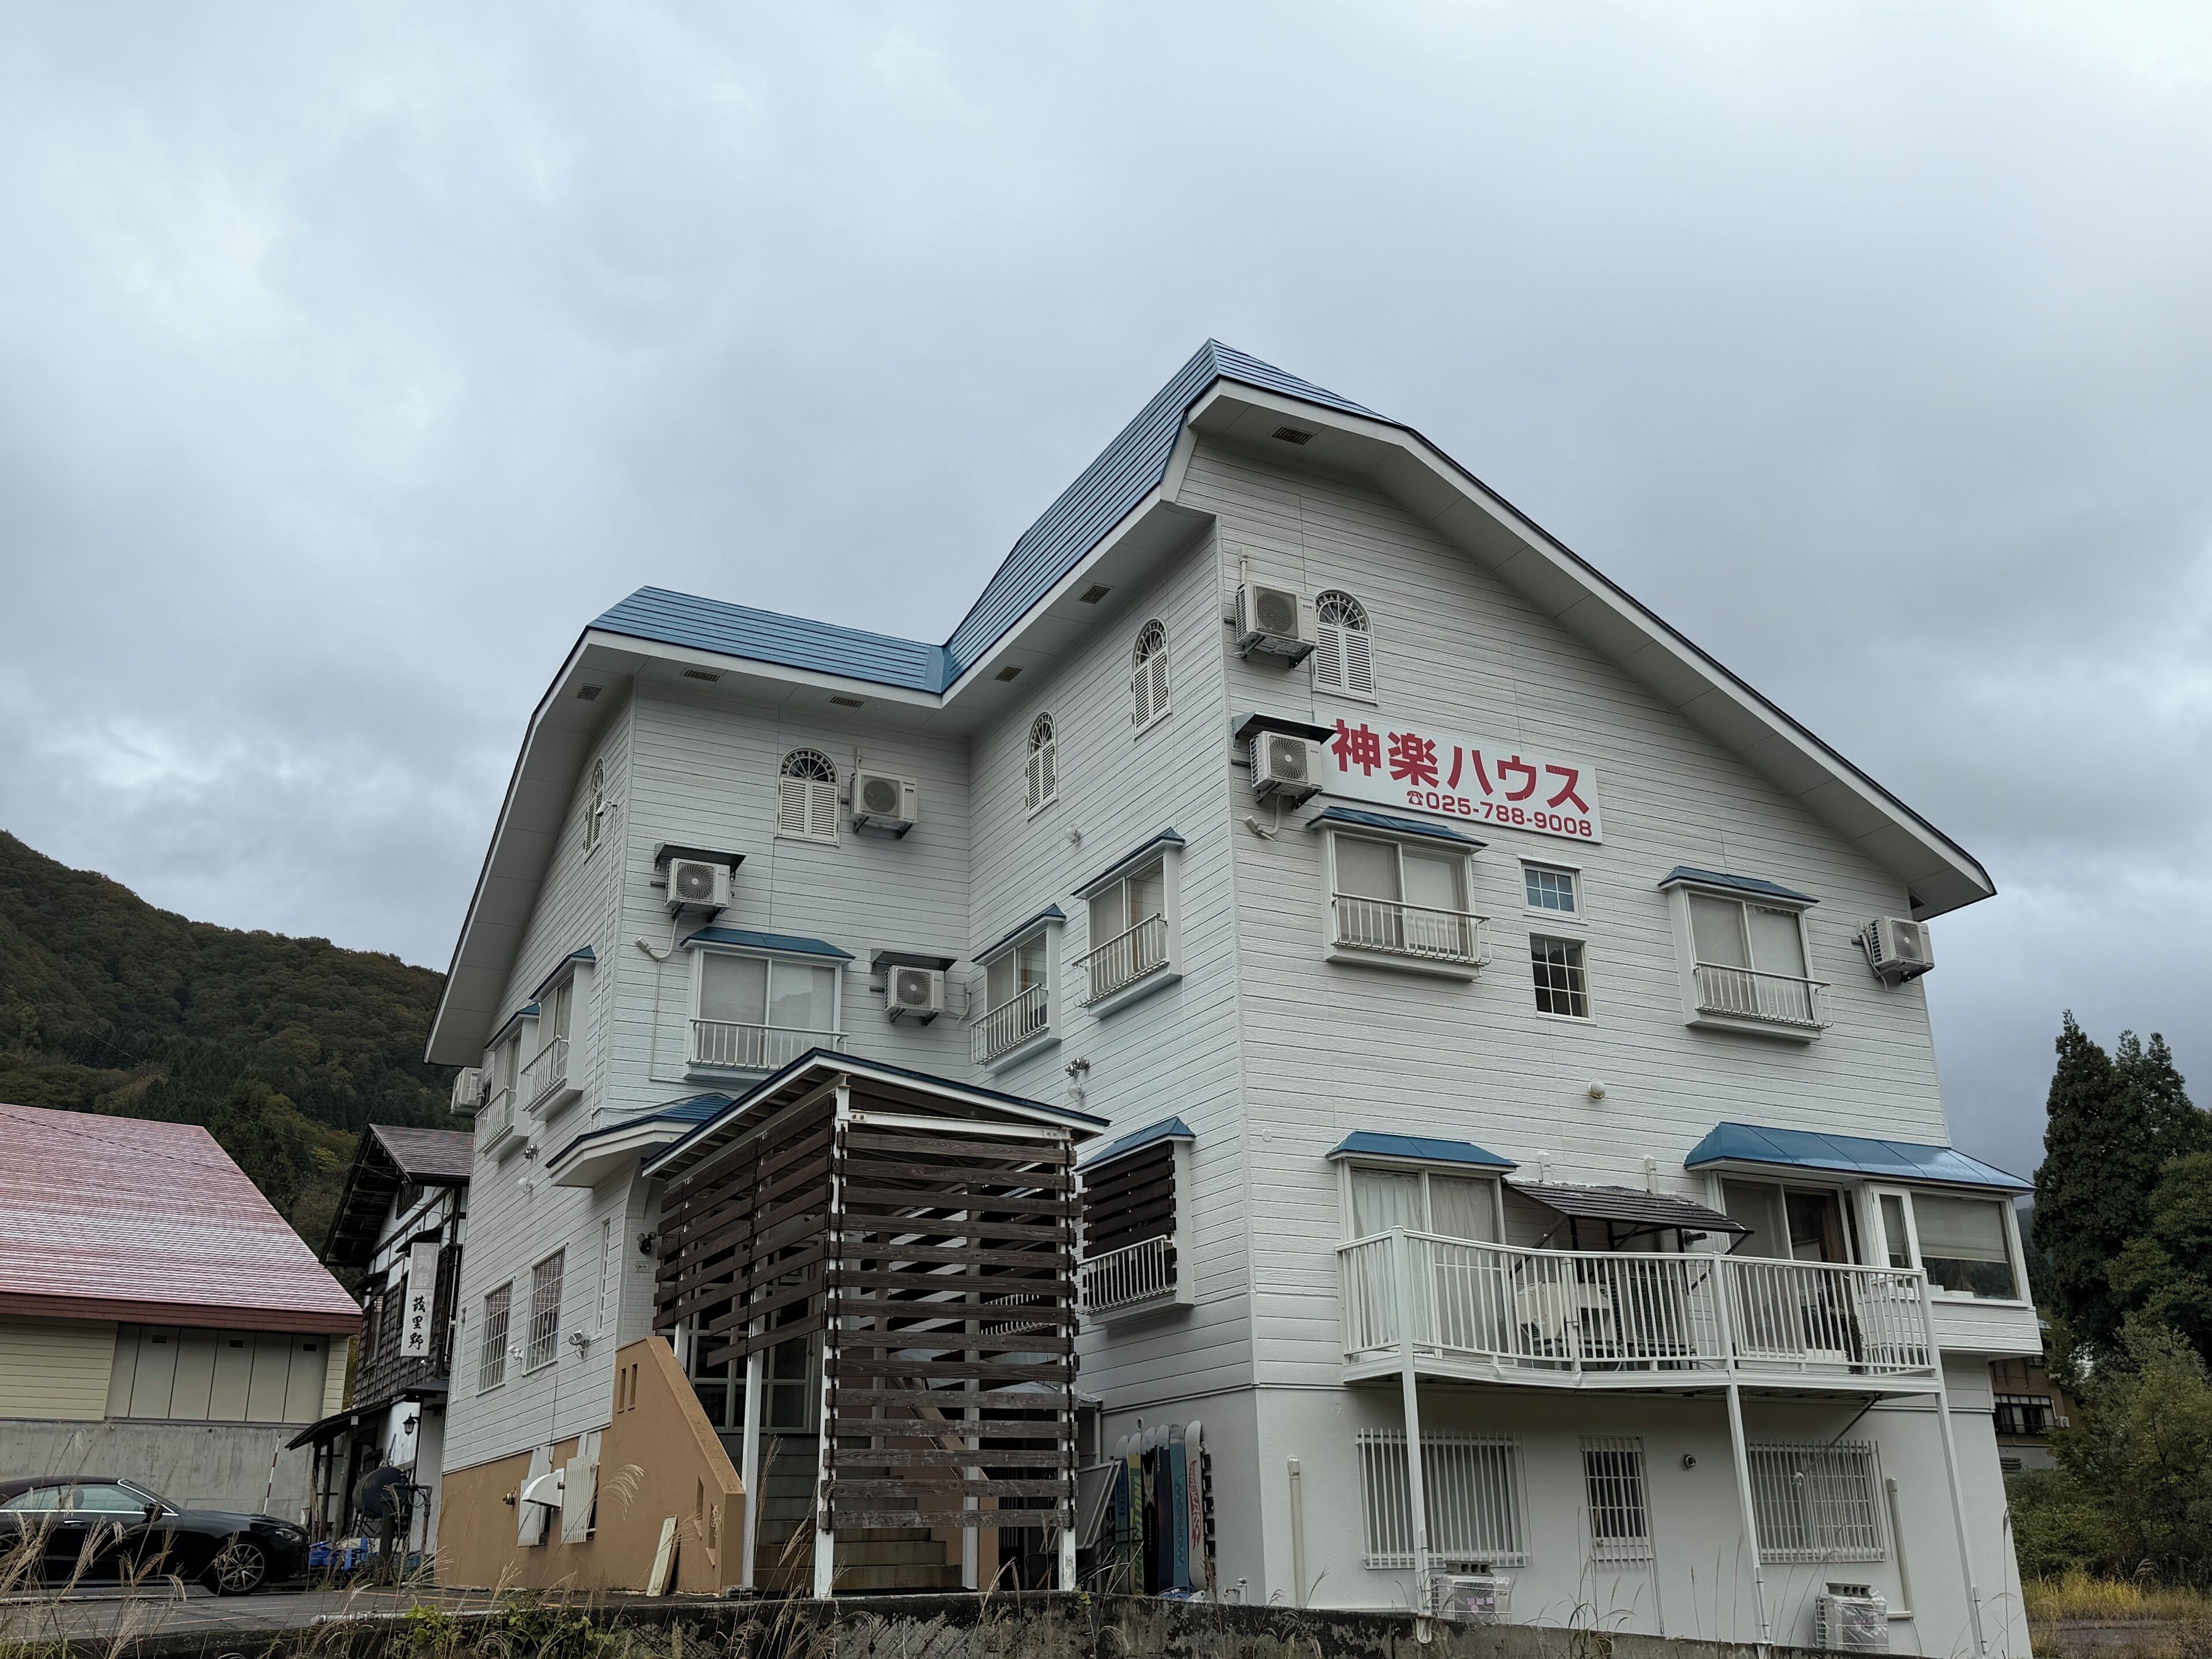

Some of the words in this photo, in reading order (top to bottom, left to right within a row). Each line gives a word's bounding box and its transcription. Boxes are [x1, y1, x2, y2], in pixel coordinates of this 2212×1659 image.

[1331, 718, 1590, 815] 神楽ハウス
[1426, 791, 1593, 837] 025-788-9008
[408, 1295, 426, 1350] 茂里野
